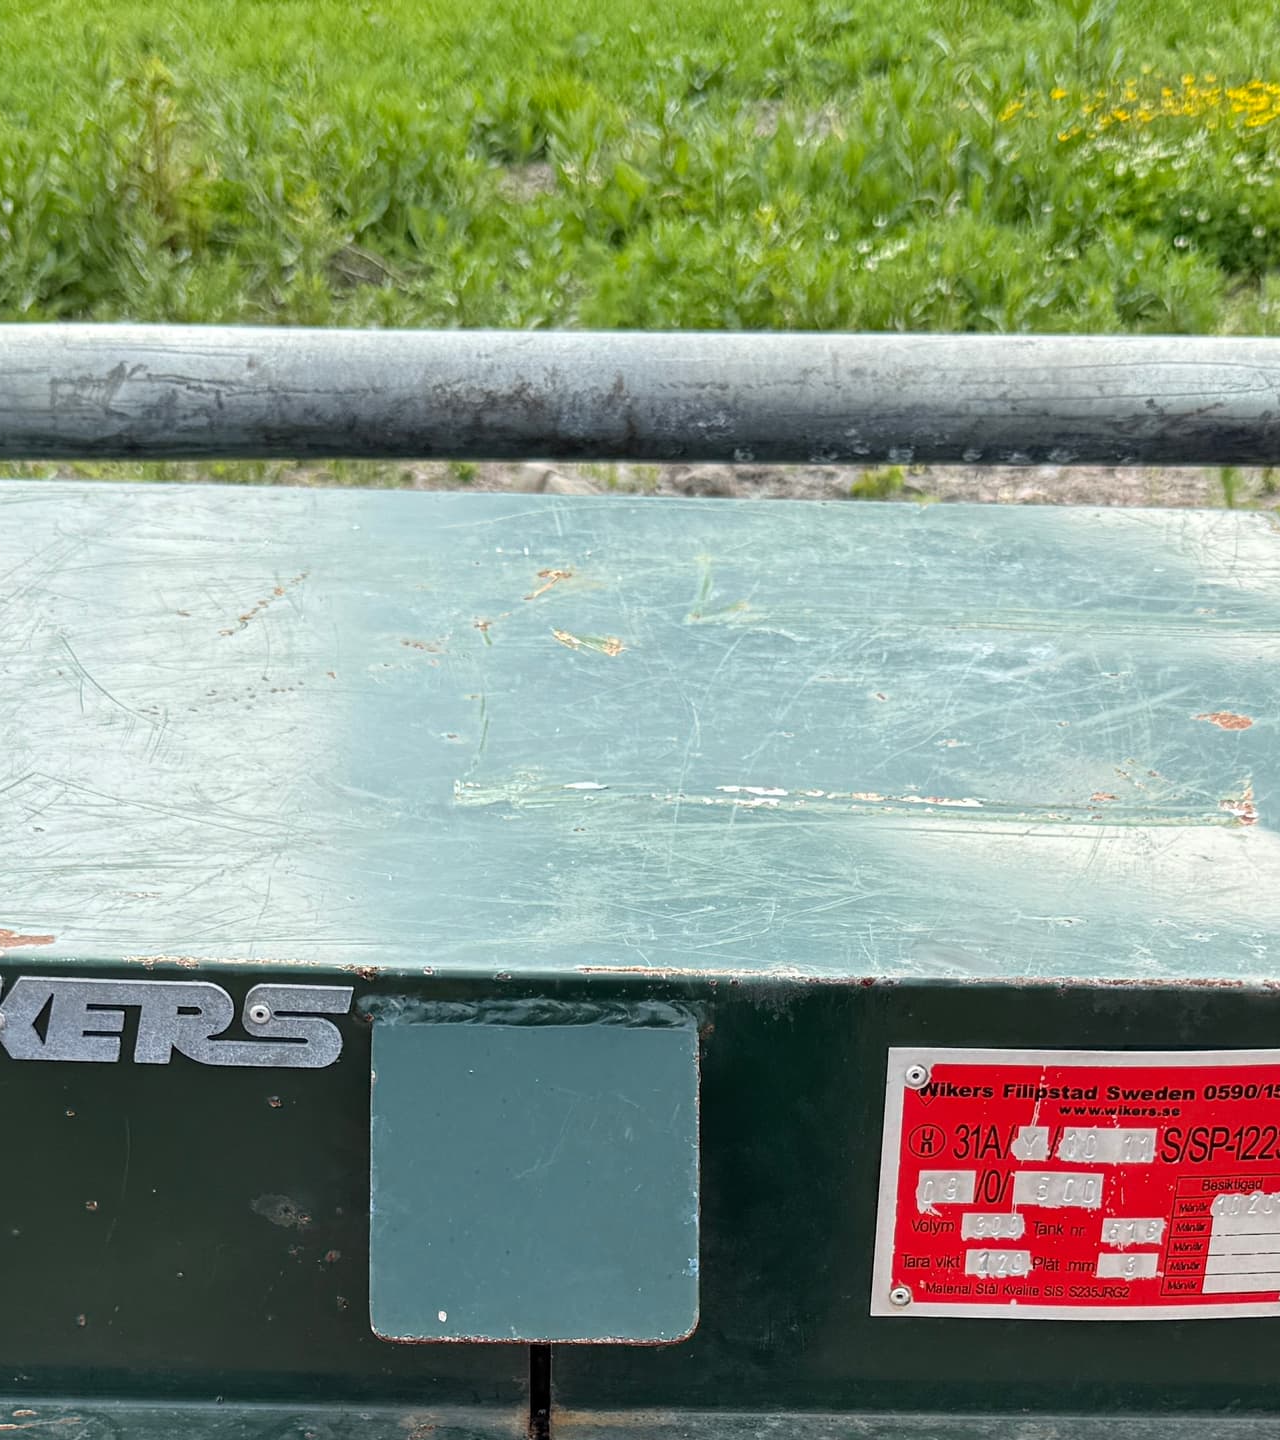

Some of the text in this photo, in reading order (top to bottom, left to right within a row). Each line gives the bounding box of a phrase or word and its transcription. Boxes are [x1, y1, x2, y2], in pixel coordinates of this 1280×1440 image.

[920, 1082, 993, 1098] Wikers
[1003, 1084, 1097, 1101] Filipstad
[1107, 1086, 1195, 1100] Sweden
[1060, 1106, 1180, 1116] www.wikers.se
[1201, 1177, 1264, 1193] Besiktigad
[912, 1219, 955, 1236] Volym
[1032, 1221, 1064, 1236] Tank
[1070, 1225, 1085, 1237] nr
[902, 1253, 930, 1268] Tara
[935, 1254, 960, 1268] vikt
[925, 1281, 970, 1296] Material
[976, 1282, 999, 1295] Stål
